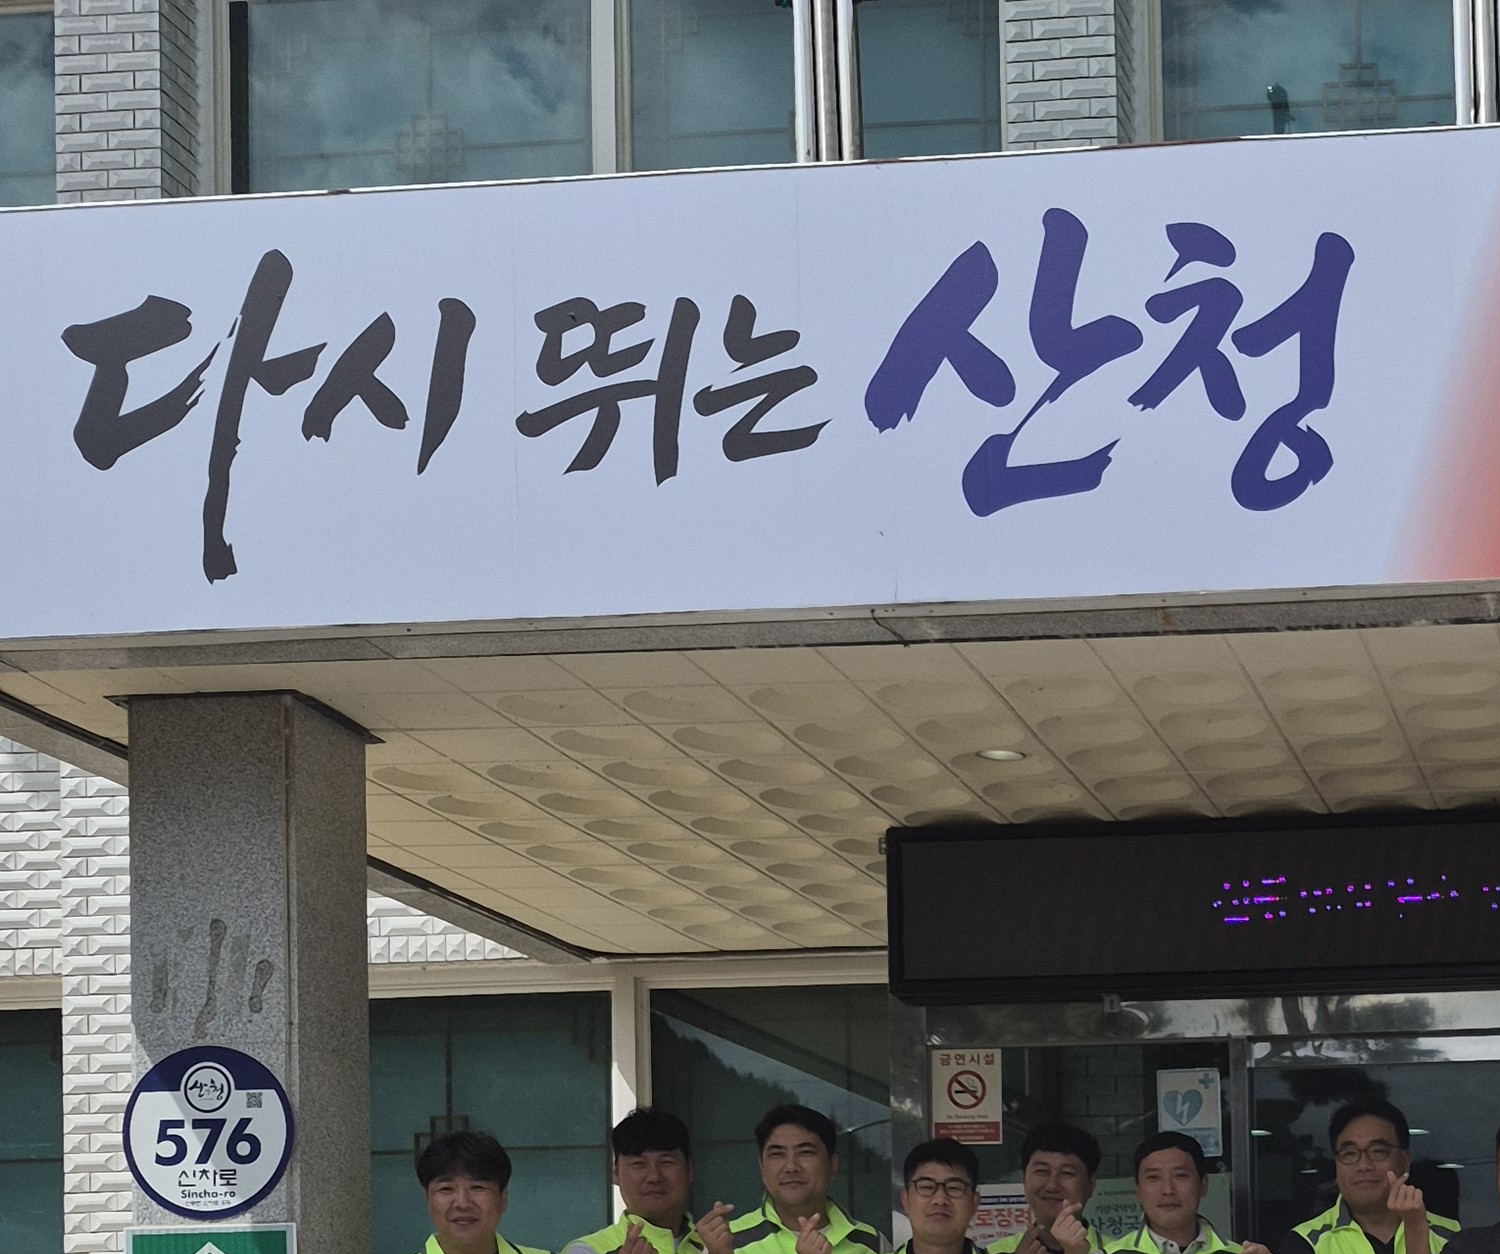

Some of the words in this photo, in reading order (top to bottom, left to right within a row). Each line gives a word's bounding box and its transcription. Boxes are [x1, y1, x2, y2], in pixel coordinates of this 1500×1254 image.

[61, 248, 476, 585] 다시
[516, 293, 832, 487] 뛰는
[863, 206, 1356, 517] 산청
[939, 1053, 996, 1067] 금연시설
[188, 1078, 225, 1101] 산청
[154, 1117, 262, 1167] 576
[178, 1169, 238, 1188] 신차로
[180, 1189, 236, 1199] Sincha-ro
[975, 1207, 1032, 1228] 로장려
